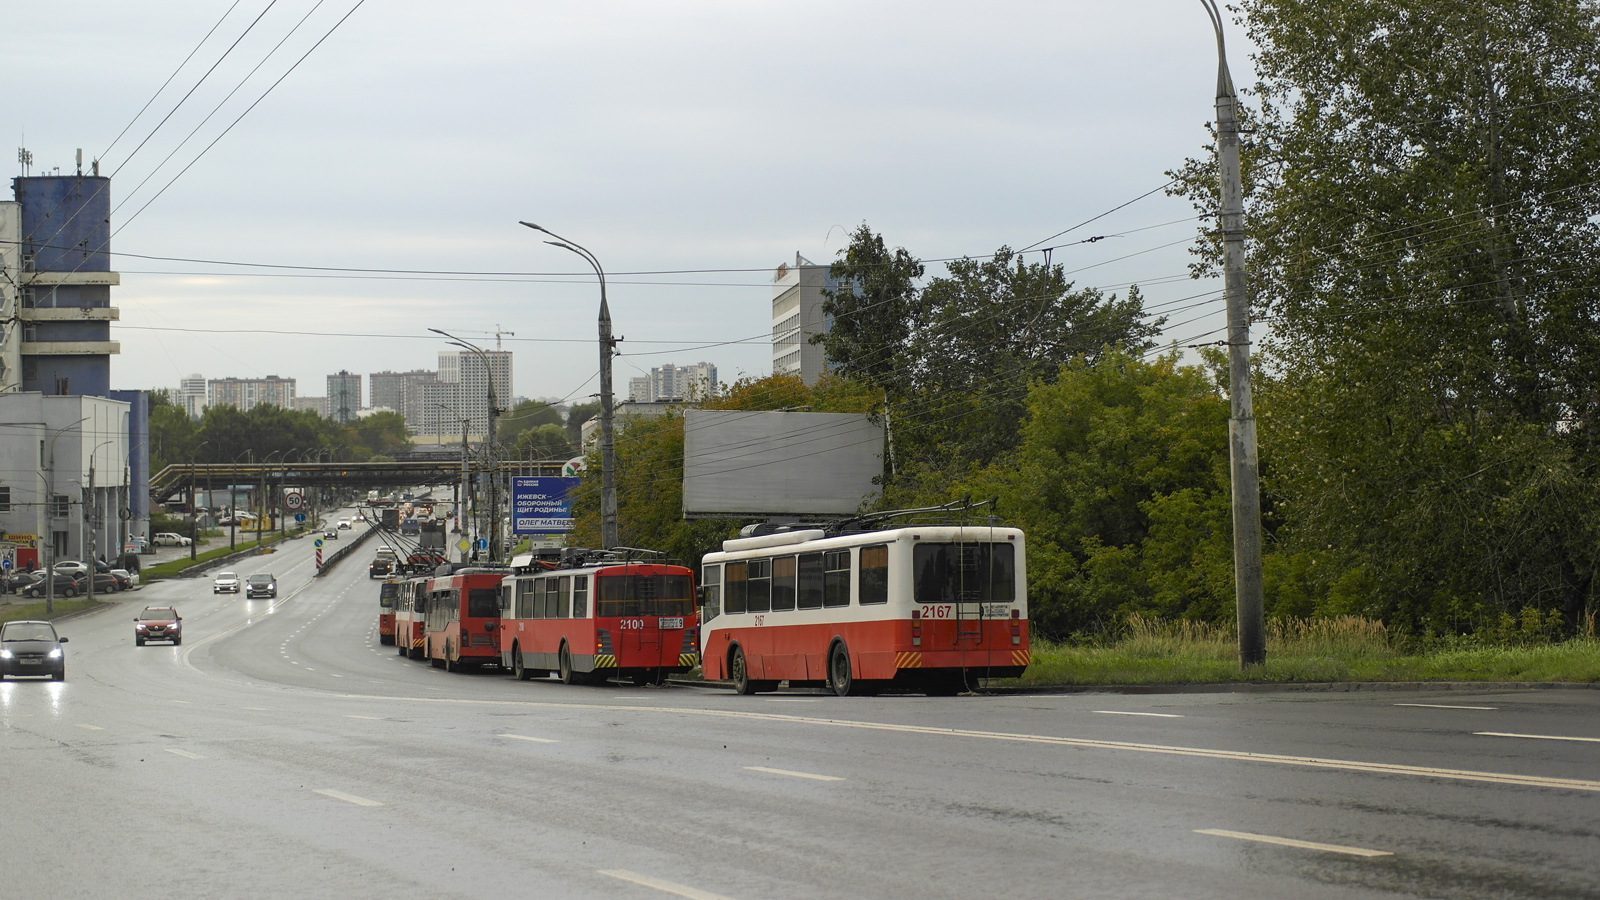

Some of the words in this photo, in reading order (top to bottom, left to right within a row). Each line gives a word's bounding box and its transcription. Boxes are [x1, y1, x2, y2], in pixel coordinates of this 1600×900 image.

[289, 496, 300, 504] 50
[922, 606, 952, 618] 2167
[620, 620, 644, 629] 2100
[754, 615, 764, 626] 2167
